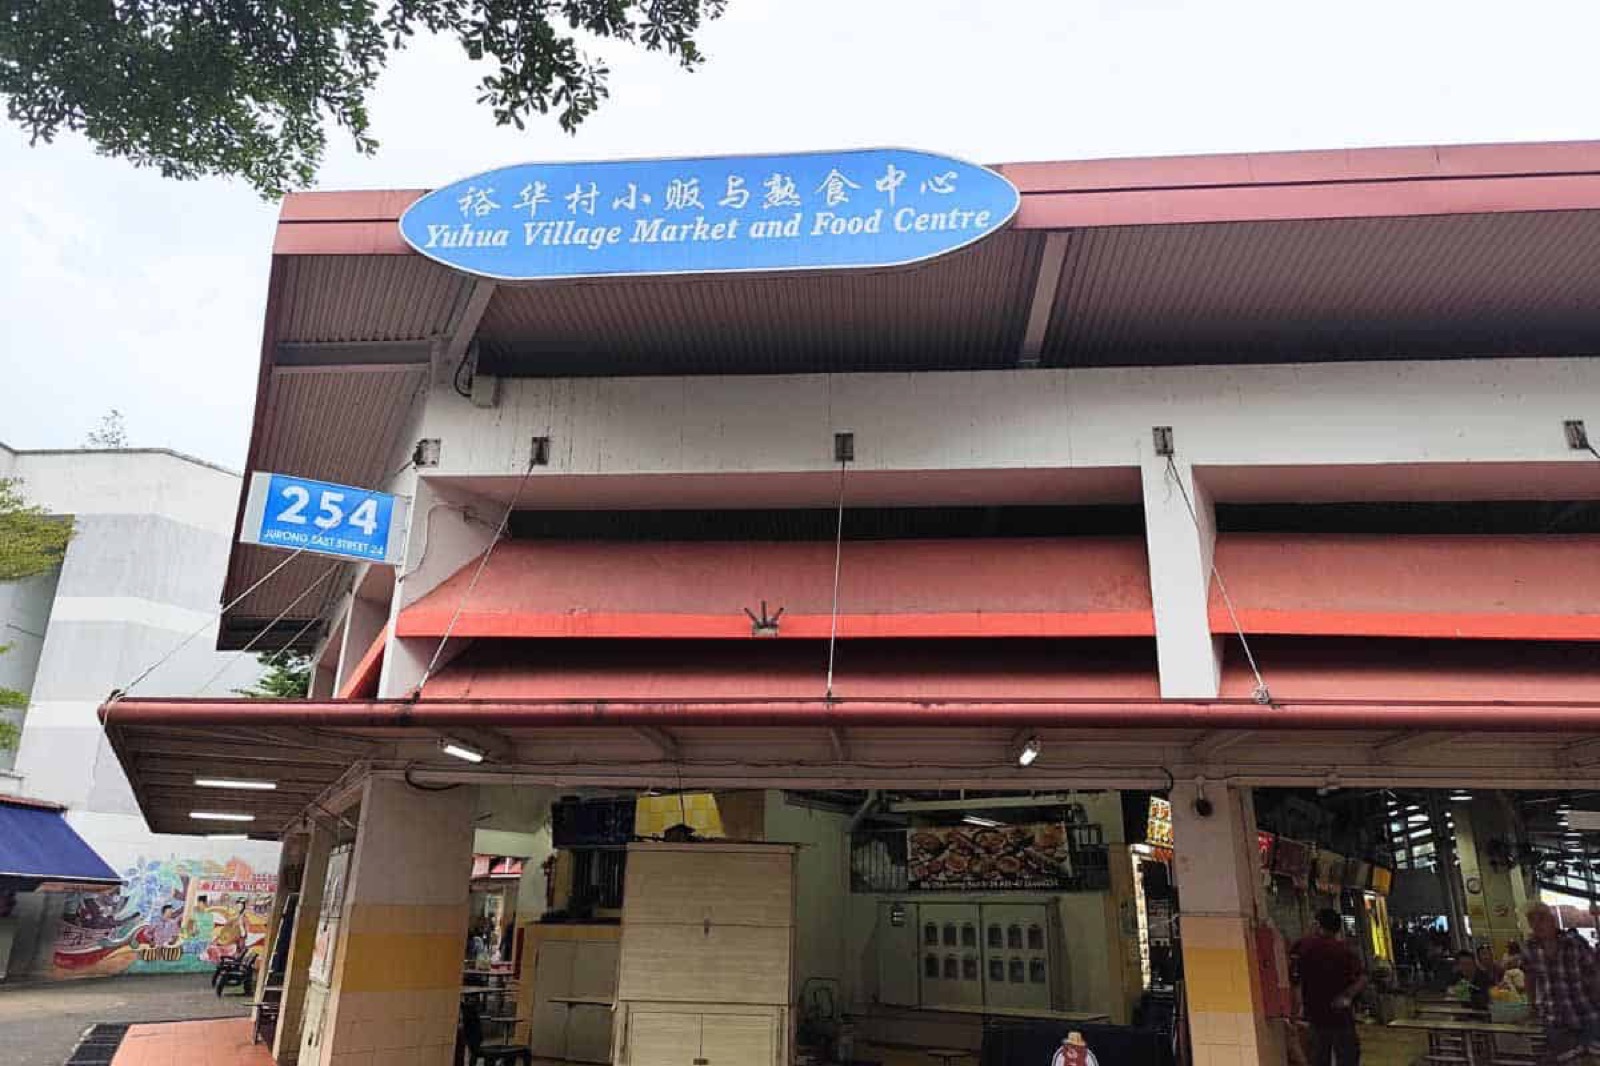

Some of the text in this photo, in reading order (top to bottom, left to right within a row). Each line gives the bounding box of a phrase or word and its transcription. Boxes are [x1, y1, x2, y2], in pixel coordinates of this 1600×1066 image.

[457, 164, 959, 217] 裕华村小贩与熟食中心
[424, 207, 992, 250] Yuhua Village Market and Food Centre
[276, 485, 378, 536] 254
[336, 539, 368, 552] STREET
[370, 545, 384, 555] 24
